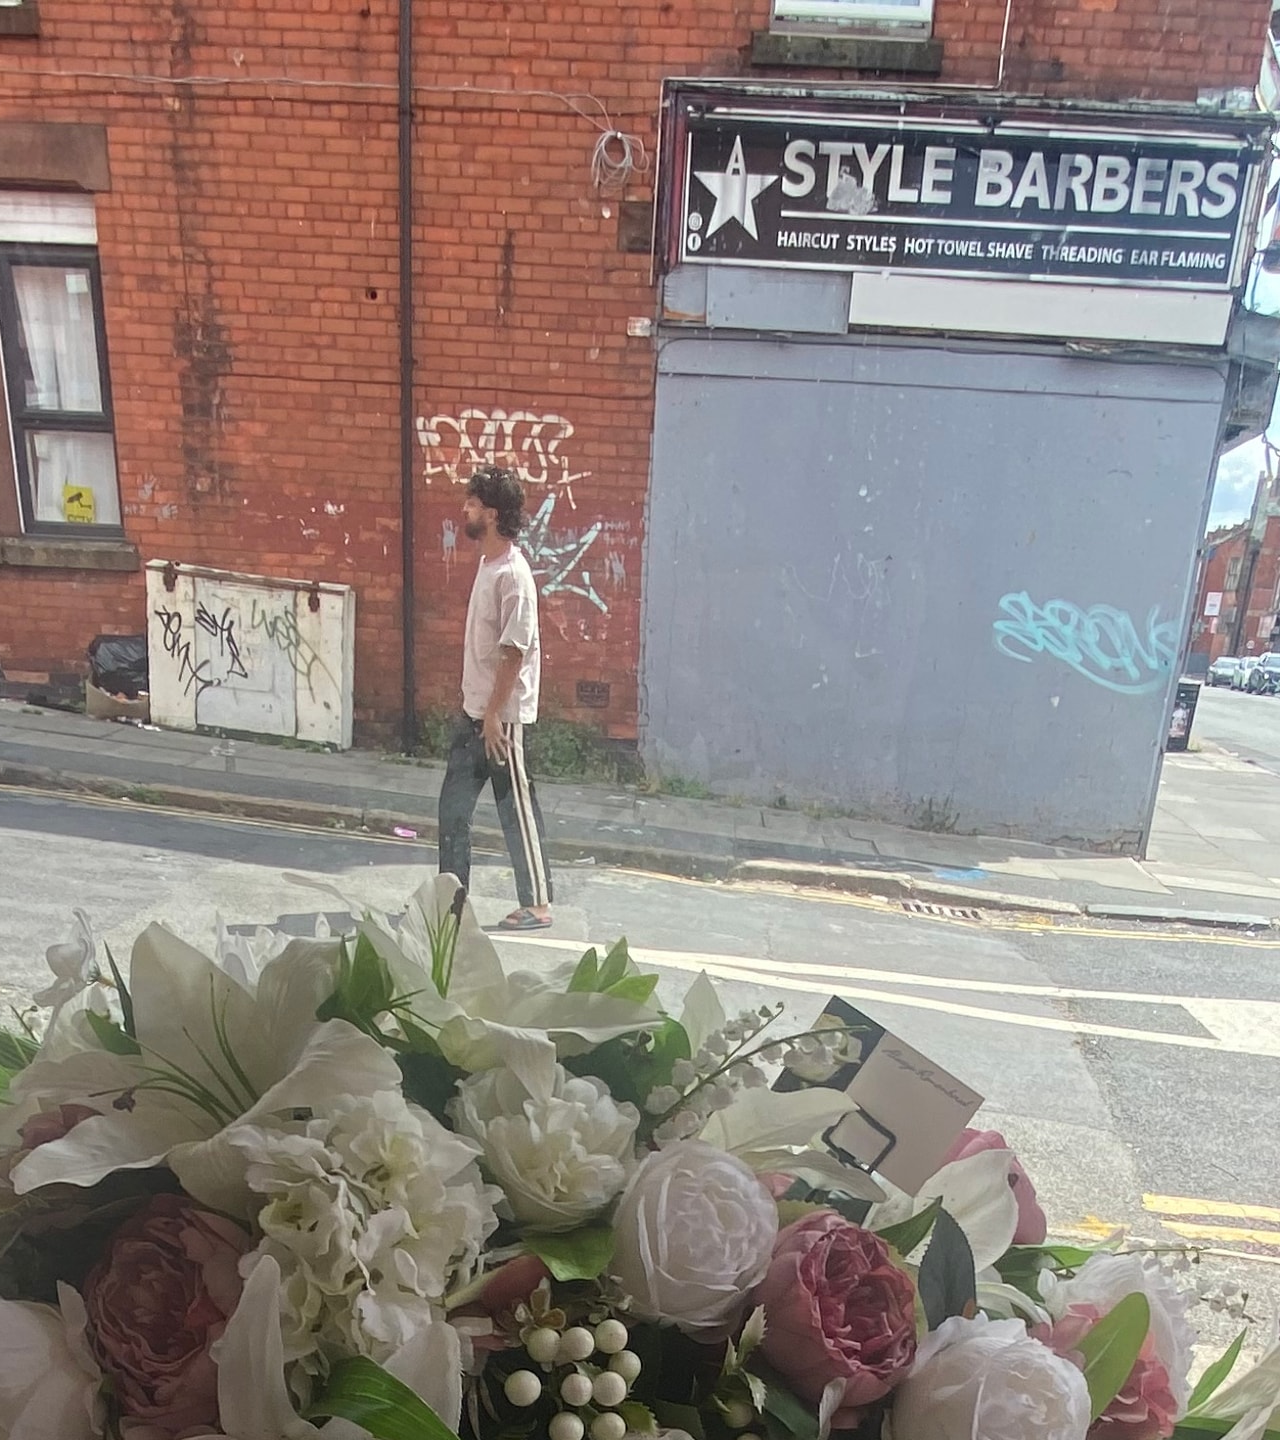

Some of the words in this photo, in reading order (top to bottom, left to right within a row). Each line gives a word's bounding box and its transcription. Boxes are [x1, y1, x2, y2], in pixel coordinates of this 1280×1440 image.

[782, 139, 957, 204] STYLE
[974, 149, 1239, 219] BARBERS
[777, 231, 839, 250] HAIRCUT
[846, 235, 897, 252] STYLES
[904, 238, 935, 254] HOT
[937, 239, 985, 257] TOWEL
[988, 242, 1034, 260] SHAVE
[1042, 245, 1124, 264] THREADING
[1130, 249, 1158, 266] EAR
[1161, 251, 1226, 269] FLAMING
